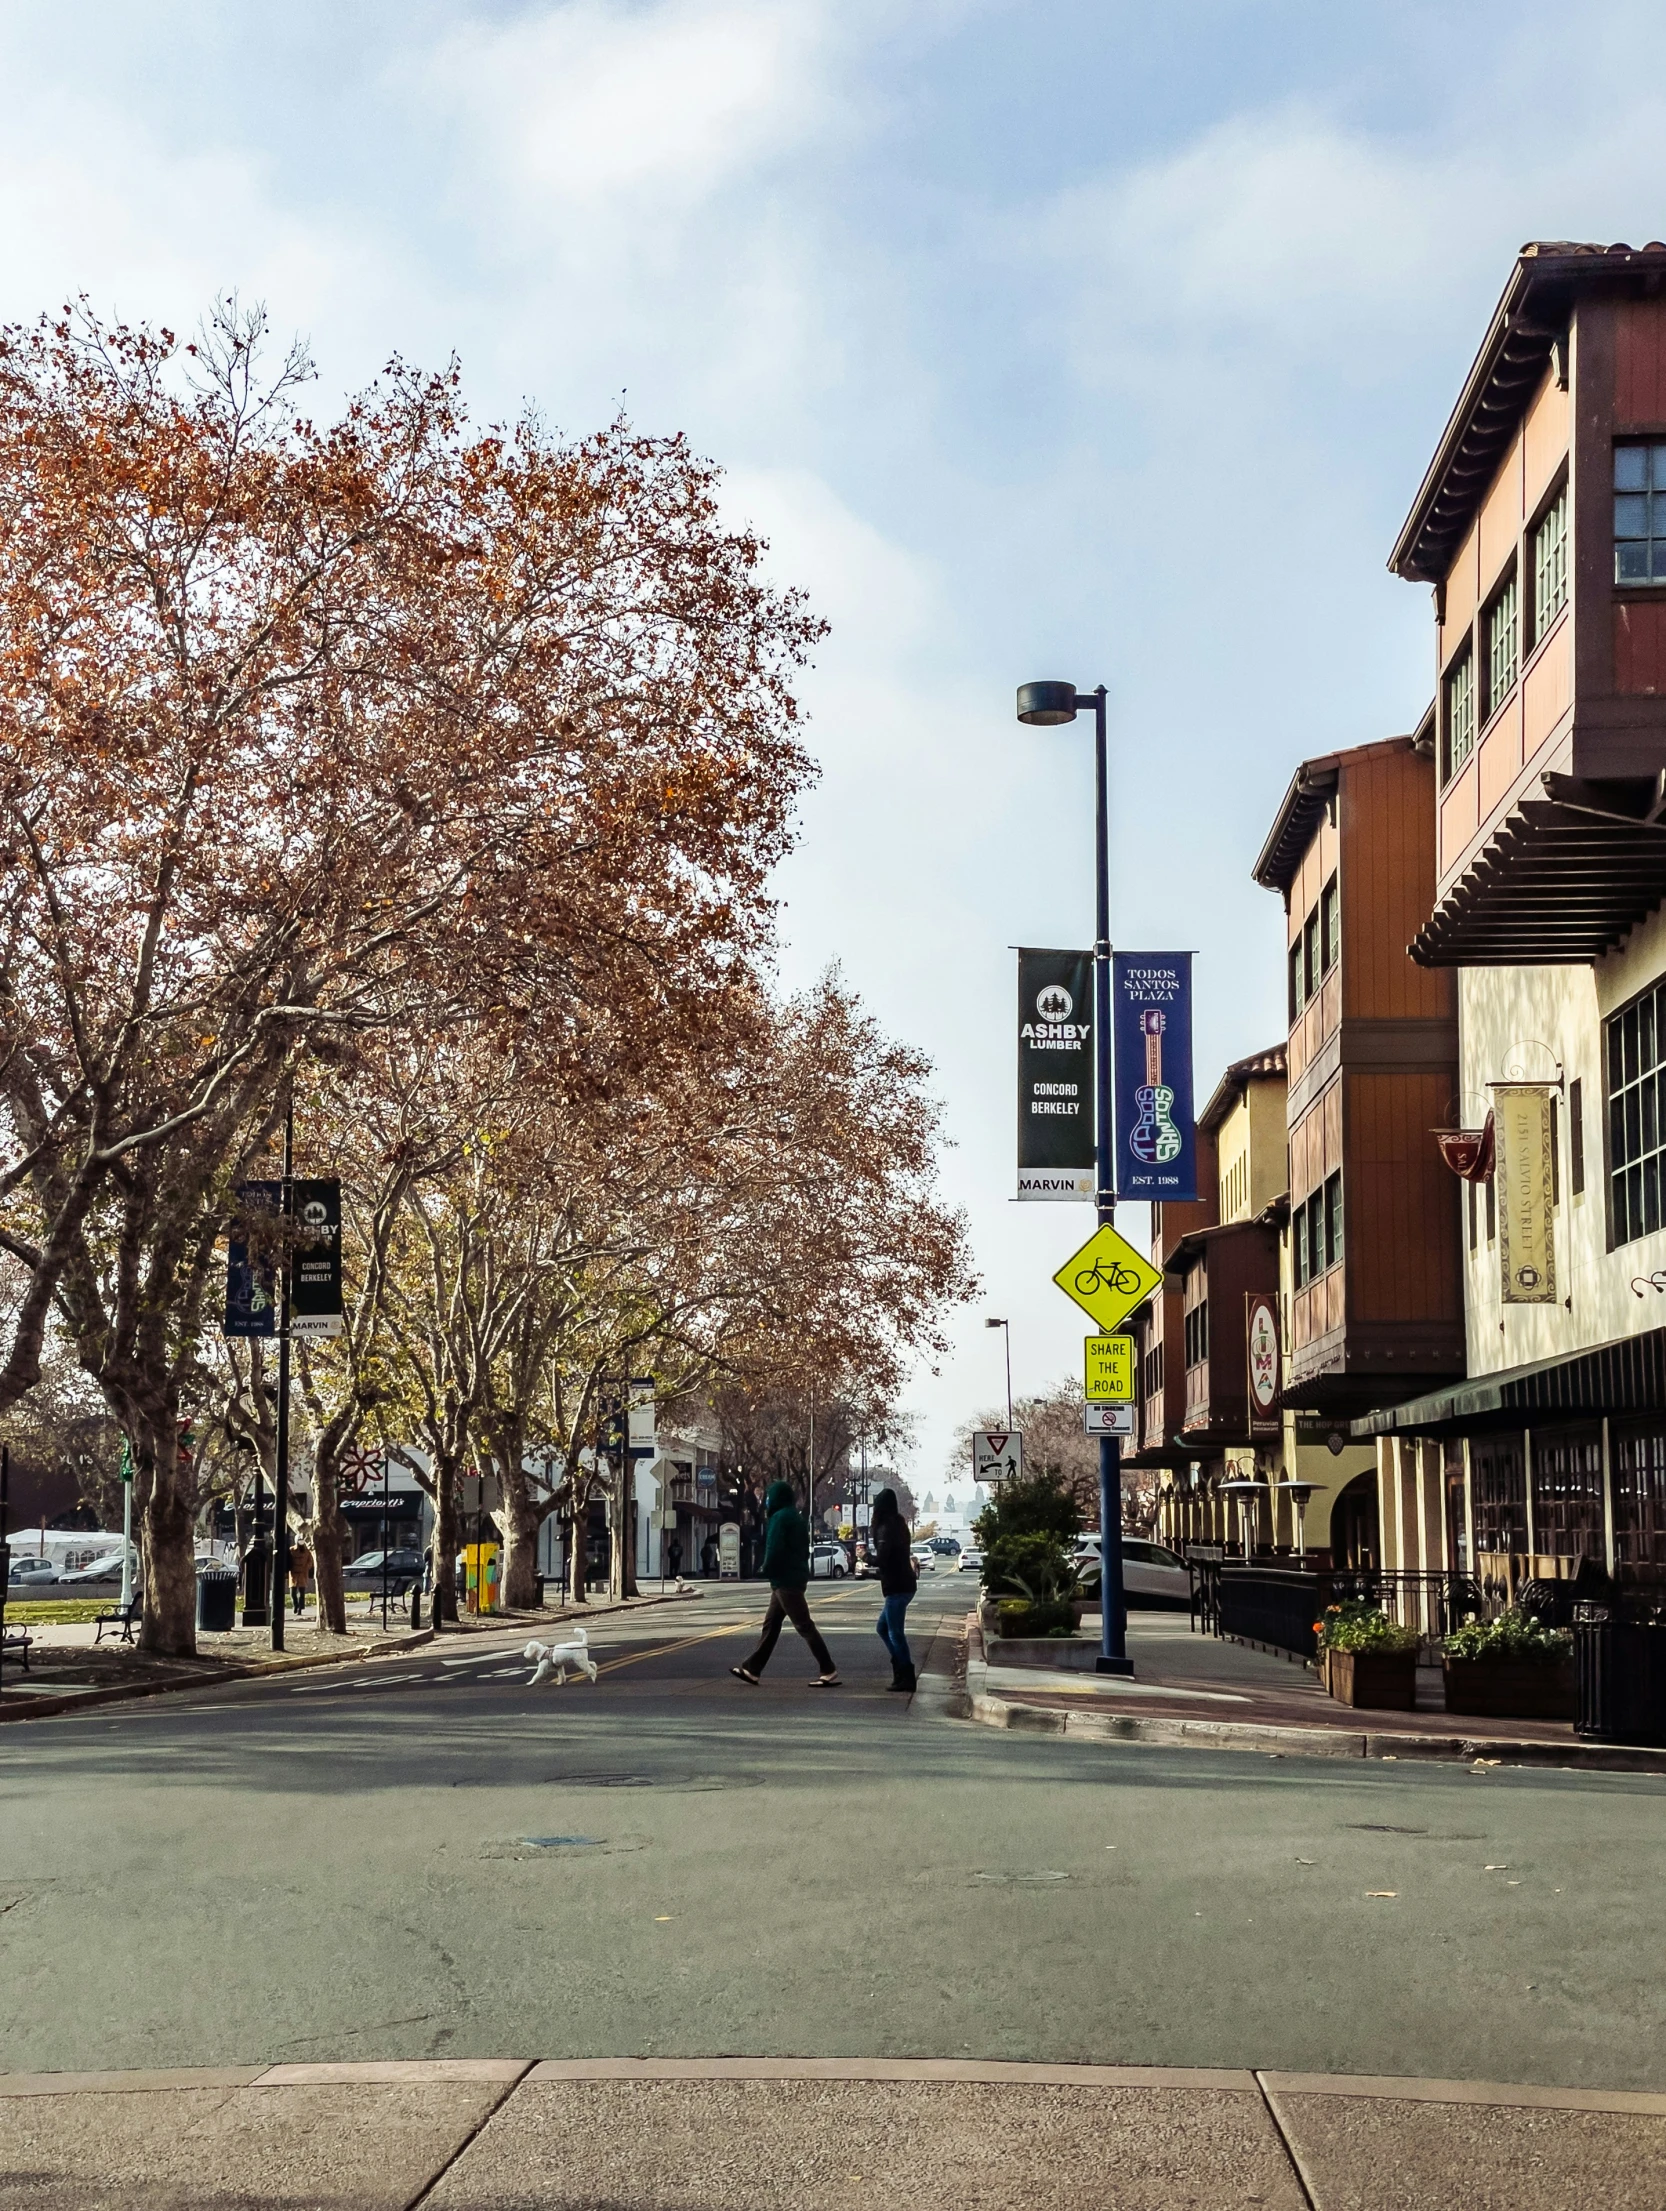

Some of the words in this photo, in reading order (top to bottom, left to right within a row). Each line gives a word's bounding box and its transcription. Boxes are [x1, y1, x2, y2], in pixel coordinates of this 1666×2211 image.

[1127, 969, 1176, 979] TODOS
[1123, 980, 1180, 990] SANTOS
[1129, 991, 1174, 1001] PLAZA
[1020, 1023, 1091, 1040] ASHBY
[1030, 1040, 1082, 1050] LUMBER
[1033, 1083, 1078, 1097] CONCORD
[1031, 1102, 1080, 1115] BERKELEY
[1133, 1088, 1155, 1159] TODOS
[1155, 1088, 1179, 1161] SANTOS
[1517, 1113, 1527, 1141] 2151
[1519, 1146, 1531, 1195] SALVIO
[1020, 1179, 1075, 1191] MARVIN
[1132, 1176, 1155, 1185] EST.
[1157, 1176, 1179, 1185] 1988
[1521, 1200, 1533, 1249] STREET
[302, 1262, 331, 1270] CONCORD
[300, 1273, 332, 1282] BERKELEY
[294, 1322, 328, 1330] MARVIN
[1091, 1343, 1126, 1356] SHARE
[1255, 1317, 1273, 1390] LIMA
[1098, 1362, 1119, 1374] THE
[1094, 1380, 1124, 1392] ROAD
[994, 1468, 1003, 1476] TO
